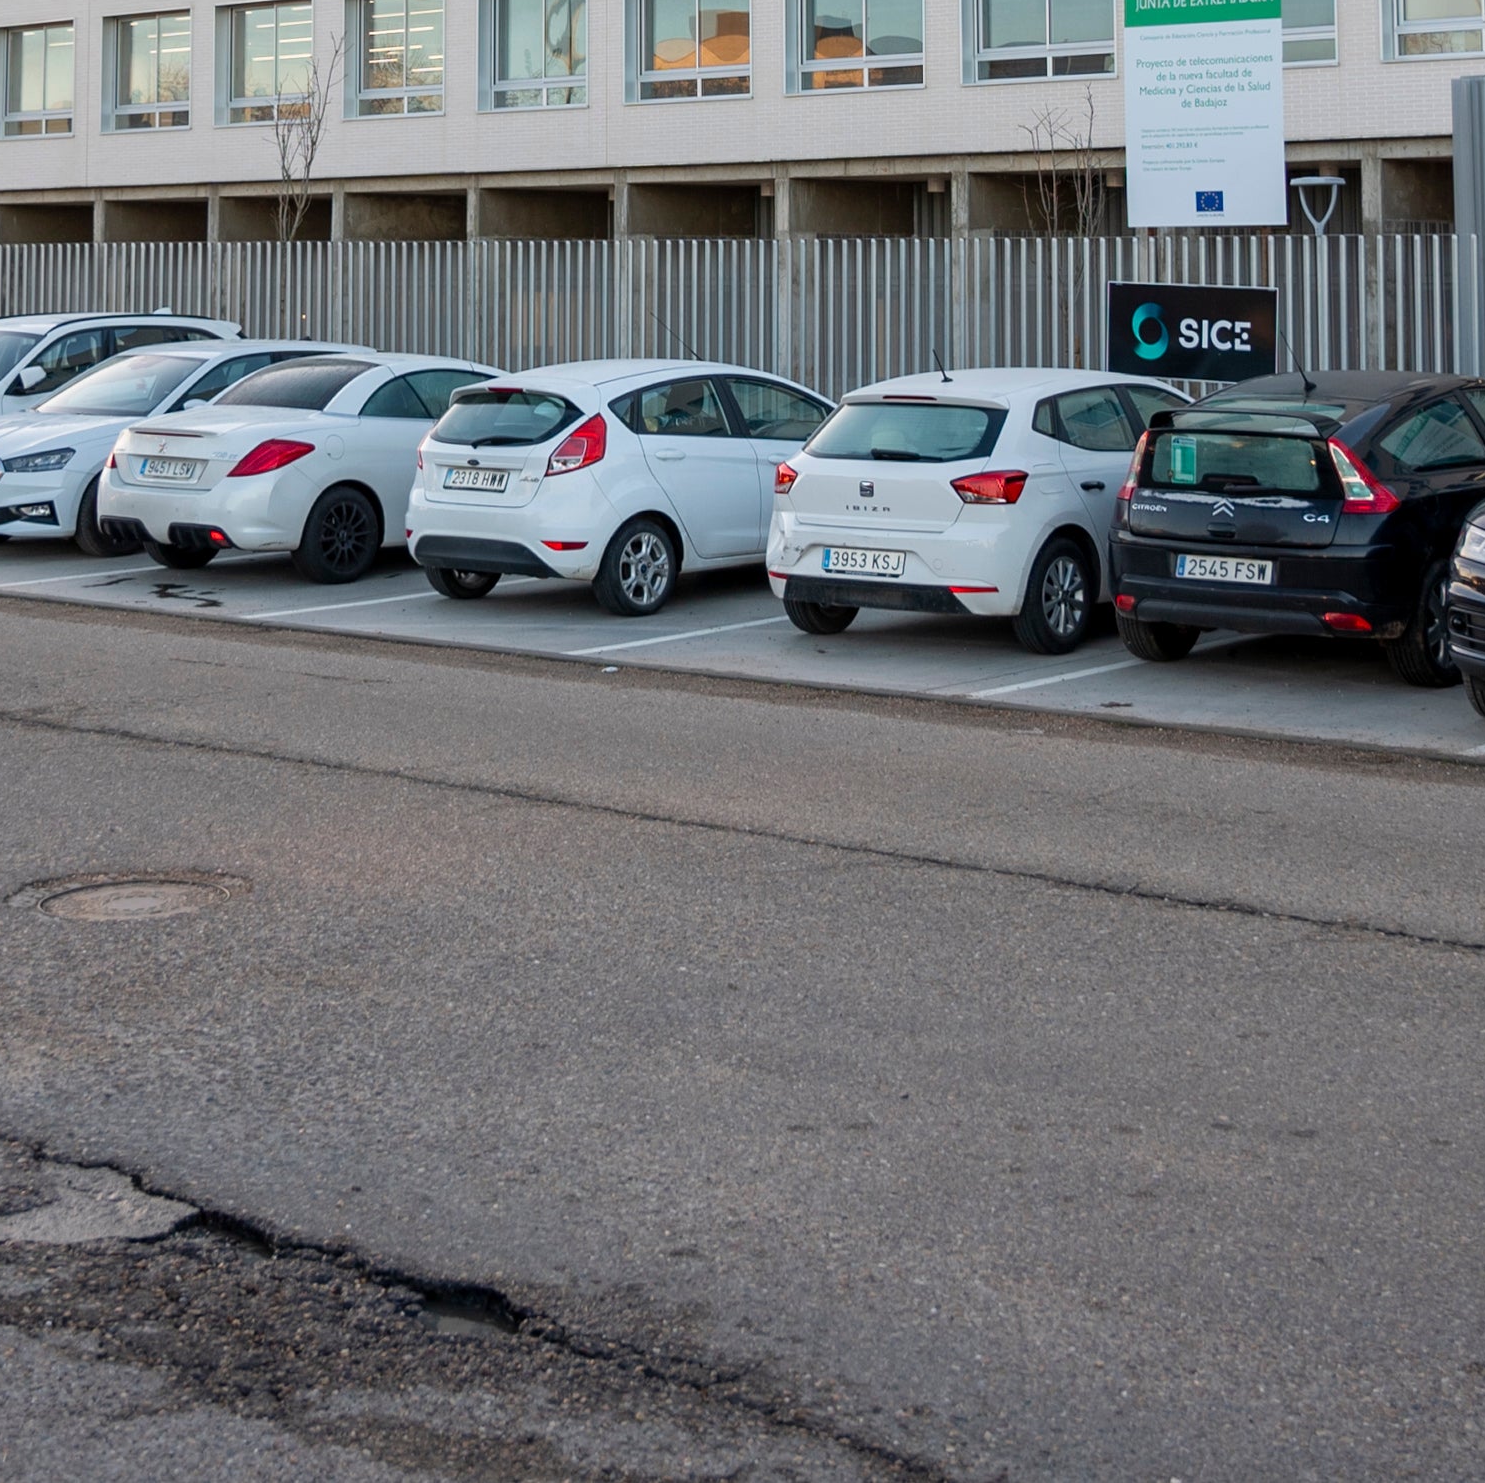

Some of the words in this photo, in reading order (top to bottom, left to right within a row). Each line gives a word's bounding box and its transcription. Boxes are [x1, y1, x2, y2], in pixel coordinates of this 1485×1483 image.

[1136, 58, 1174, 71] Proyecto
[1176, 57, 1187, 67] de
[1189, 54, 1273, 67] telecomunicaciones
[1156, 72, 1167, 82] de
[1169, 71, 1176, 81] la
[1178, 73, 1203, 81] nueva
[1205, 68, 1239, 79] facultad
[1241, 68, 1253, 78] de
[1139, 85, 1176, 96] Medicina
[1178, 87, 1183, 96] y
[1186, 83, 1222, 95] Ciencias
[1224, 82, 1235, 93] de
[1237, 82, 1245, 92] la
[1247, 81, 1271, 92] Salud
[1181, 98, 1192, 108] de
[1194, 97, 1228, 109] Badajoz
[1178, 318, 1252, 352] SICE
[148, 461, 170, 475] 9451
[1175, 448, 1194, 481] L
[452, 470, 480, 485] 2318
[481, 472, 506, 488] HWW
[1303, 513, 1330, 524] C4
[832, 551, 867, 569] 3953
[872, 553, 901, 571] KSJ
[1187, 559, 1229, 578] 2545
[1234, 563, 1266, 581] FSW
